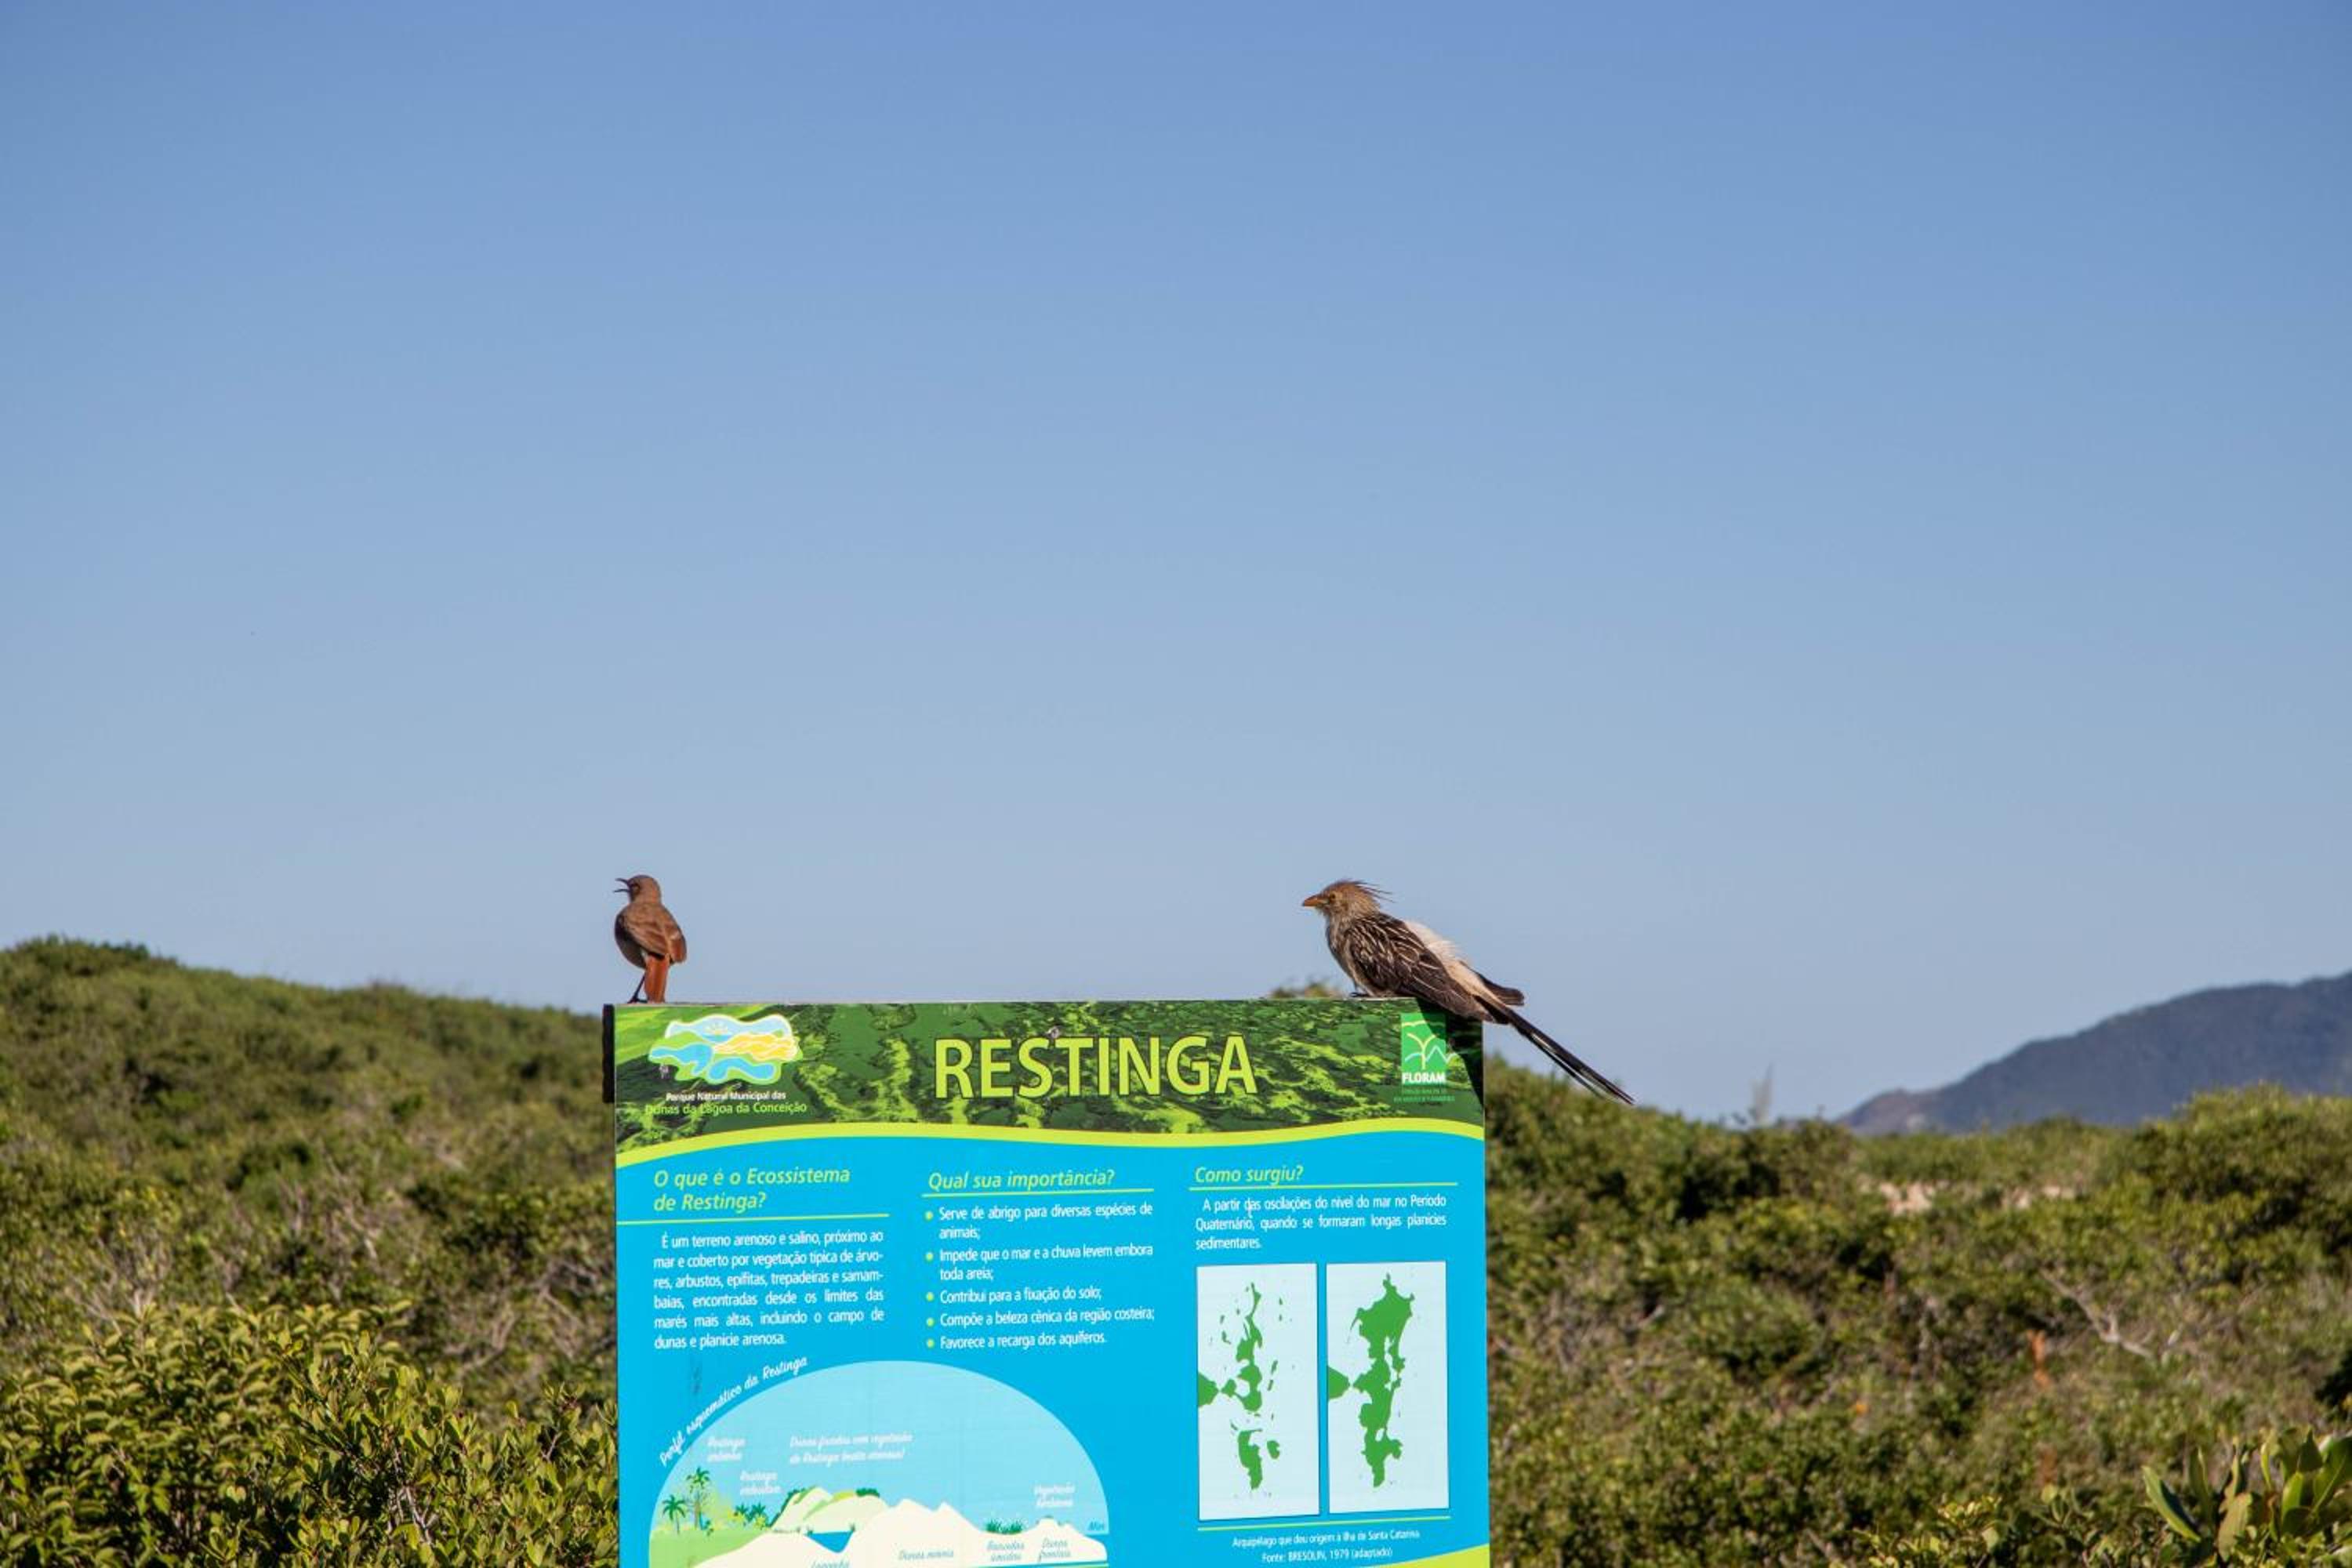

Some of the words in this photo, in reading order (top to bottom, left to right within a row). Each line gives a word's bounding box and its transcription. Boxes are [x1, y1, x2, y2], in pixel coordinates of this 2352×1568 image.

[935, 1036, 1258, 1098] RESTINGA
[1402, 1073, 1446, 1083] FLORAM
[666, 1093, 695, 1102] Parque
[729, 1092, 769, 1101] Municipal
[645, 1105, 680, 1114] Dunas
[684, 1104, 697, 1114] da
[700, 1103, 733, 1116] Lagoa
[736, 1103, 750, 1112] da
[753, 1102, 807, 1115] Conceição
[654, 1170, 668, 1187] O
[674, 1173, 707, 1190] que
[713, 1168, 724, 1185] é
[730, 1172, 741, 1185] o
[746, 1167, 851, 1185] Ecossistema
[928, 1172, 969, 1189] Qual
[973, 1175, 1001, 1189] sua
[1007, 1169, 1115, 1190] importância?
[1196, 1167, 1241, 1183] Como
[1246, 1165, 1304, 1185] surgiu?
[654, 1194, 675, 1211] de
[681, 1192, 767, 1214] Restinga?
[939, 1207, 967, 1220] Serve
[971, 1207, 984, 1219] de
[989, 1204, 1018, 1221] abrigo
[1025, 1207, 1047, 1221] para
[1051, 1203, 1091, 1216] diversas
[1095, 1203, 1135, 1218] espécies
[1139, 1202, 1152, 1214] de
[1203, 1199, 1210, 1211] A
[1214, 1198, 1240, 1212] partir
[1245, 1198, 1261, 1210] das
[1265, 1196, 1311, 1213] oscilações
[1315, 1196, 1327, 1208] do
[1356, 1195, 1370, 1207] do
[1373, 1196, 1391, 1207] mar
[1395, 1195, 1407, 1207] no
[939, 1225, 980, 1240] animais;
[1261, 1218, 1297, 1232] quando
[1303, 1218, 1312, 1229] se
[1318, 1214, 1365, 1228] formaram
[1371, 1214, 1402, 1229] longas
[662, 1231, 669, 1248] É
[672, 1235, 688, 1247] um
[692, 1233, 731, 1247] terreno
[734, 1232, 775, 1246] arenoso
[779, 1232, 786, 1245] e
[789, 1231, 821, 1247] salino,
[825, 1228, 867, 1247] próximo
[870, 1231, 884, 1242] ao
[1196, 1237, 1261, 1250] sedimentares.
[654, 1256, 674, 1268] mar
[678, 1256, 684, 1267] e
[688, 1253, 728, 1267] coberto
[731, 1254, 749, 1271] por
[752, 1250, 806, 1269] vegetação
[840, 1250, 853, 1262] de
[940, 1248, 977, 1264] Impede
[982, 1249, 1000, 1262] que
[1002, 1249, 1009, 1260] o
[1011, 1248, 1031, 1260] mar
[1034, 1248, 1040, 1259] e
[1043, 1248, 1048, 1258] a
[1051, 1246, 1080, 1258] chuva
[1083, 1244, 1112, 1257] levem
[1115, 1243, 1153, 1256] embora
[654, 1276, 672, 1290] res,
[676, 1272, 724, 1288] arbustos,
[771, 1270, 828, 1287] trepadeiras
[833, 1270, 838, 1282] e
[841, 1269, 884, 1281] samam-
[940, 1268, 964, 1280] toda
[966, 1268, 993, 1282] areia;
[654, 1294, 684, 1310] baias,
[693, 1292, 757, 1308] encontradas
[765, 1291, 797, 1305] desde
[805, 1292, 817, 1303] os
[824, 1290, 858, 1302] limites
[866, 1287, 884, 1301] das
[940, 1288, 986, 1304] Contribui
[989, 1290, 1012, 1303] para
[1014, 1290, 1021, 1301] a
[1024, 1287, 1059, 1302] fixação
[1062, 1287, 1076, 1299] do
[1079, 1287, 1102, 1300] solo;
[655, 1315, 687, 1328] marés
[694, 1313, 718, 1327] mais
[726, 1312, 753, 1327] altas,
[760, 1310, 808, 1324] incluindo
[814, 1312, 822, 1323] o
[828, 1310, 863, 1325] campo
[871, 1308, 884, 1320] de
[940, 1311, 982, 1329] Compõe
[986, 1314, 993, 1325] a
[995, 1311, 1027, 1324] beleza
[1031, 1309, 1062, 1323] cênica
[1065, 1308, 1077, 1321] da
[1080, 1307, 1112, 1324] região
[1114, 1306, 1154, 1321] costeira;
[655, 1334, 686, 1348] dunas
[690, 1336, 696, 1347] e
[742, 1333, 786, 1345] arenosa.
[940, 1335, 985, 1349] Favorece
[988, 1337, 994, 1348] a
[997, 1334, 1035, 1350] recarga
[1038, 1332, 1055, 1345] dos
[744, 1374, 758, 1389] da
[762, 1356, 808, 1381] Restinga
[1279, 1537, 1292, 1547] que
[1294, 1534, 1308, 1544] deu
[1308, 1534, 1334, 1545] origem
[1368, 1530, 1388, 1541] Santa
[1262, 1553, 1285, 1563] Fonte:
[1330, 1549, 1348, 1559] 1979
